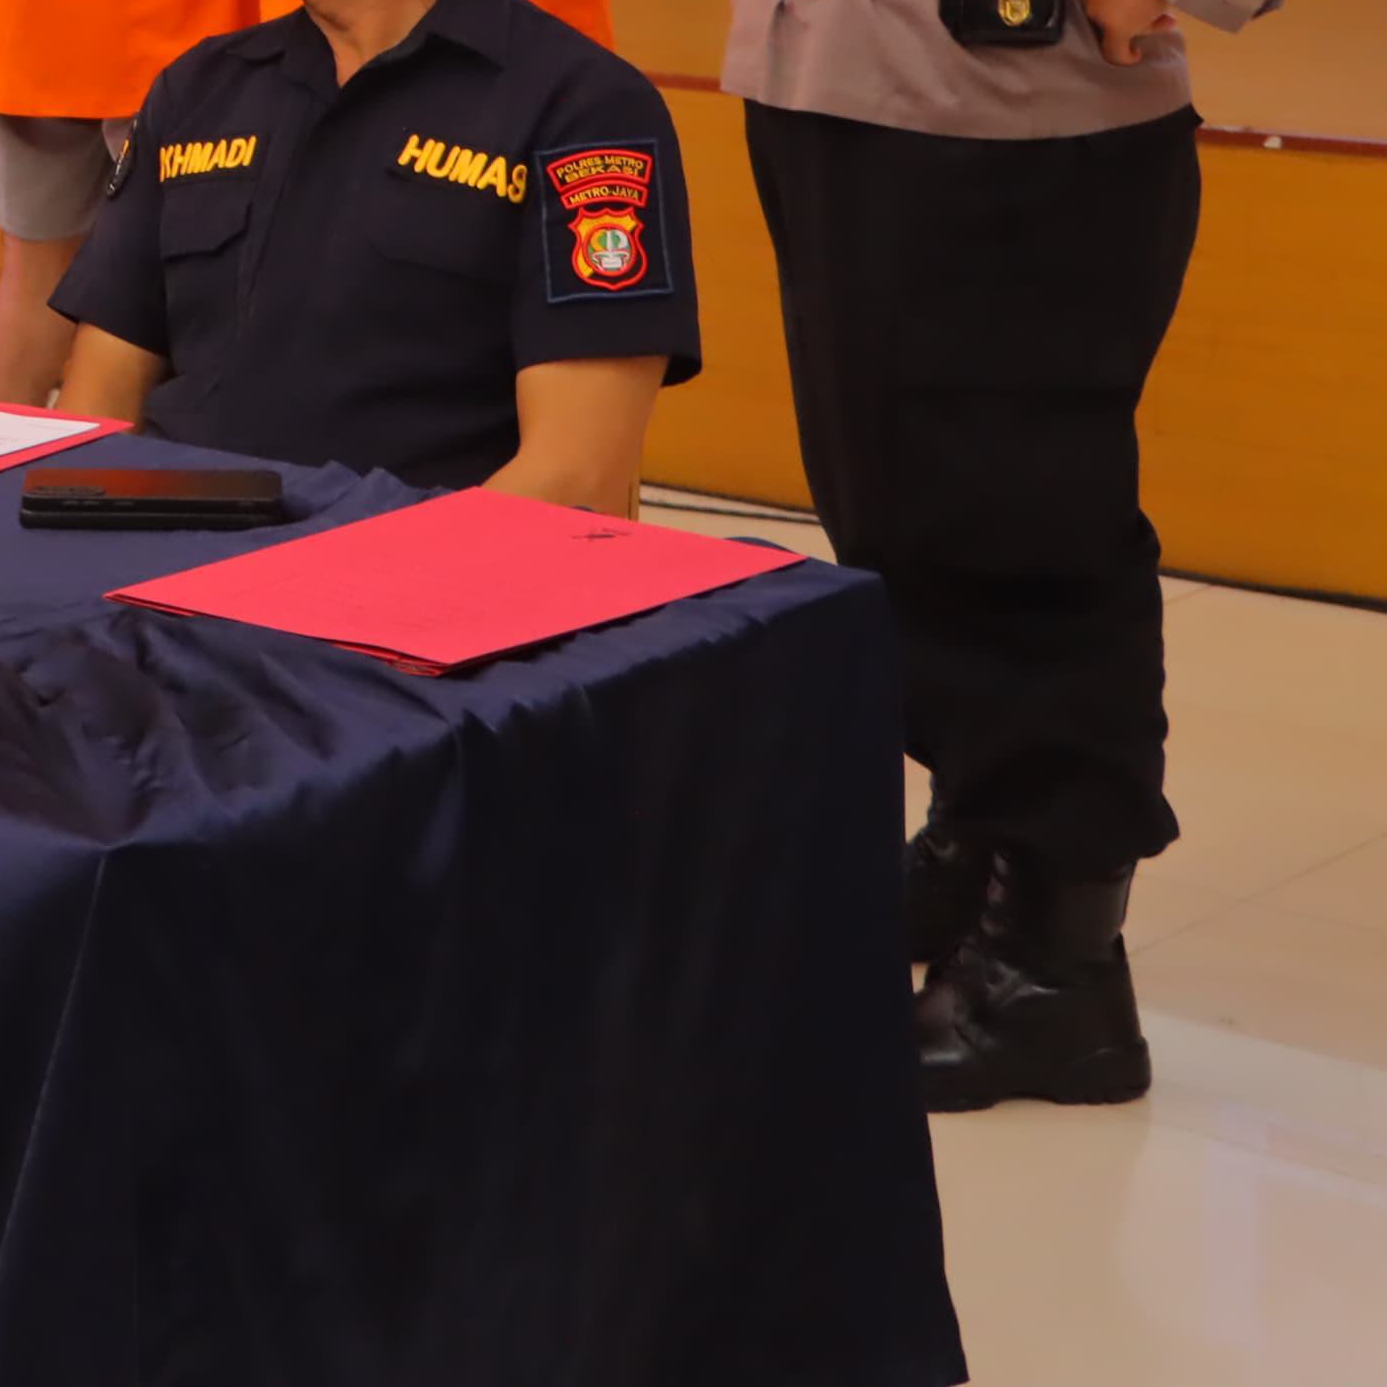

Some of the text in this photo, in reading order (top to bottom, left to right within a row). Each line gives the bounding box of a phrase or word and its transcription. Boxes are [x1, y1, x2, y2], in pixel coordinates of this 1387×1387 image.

[397, 134, 527, 204] HUMAS
[556, 155, 644, 179] POLRES METRO
[564, 165, 639, 183] BEKASI
[569, 185, 639, 205] METRO JAYA
